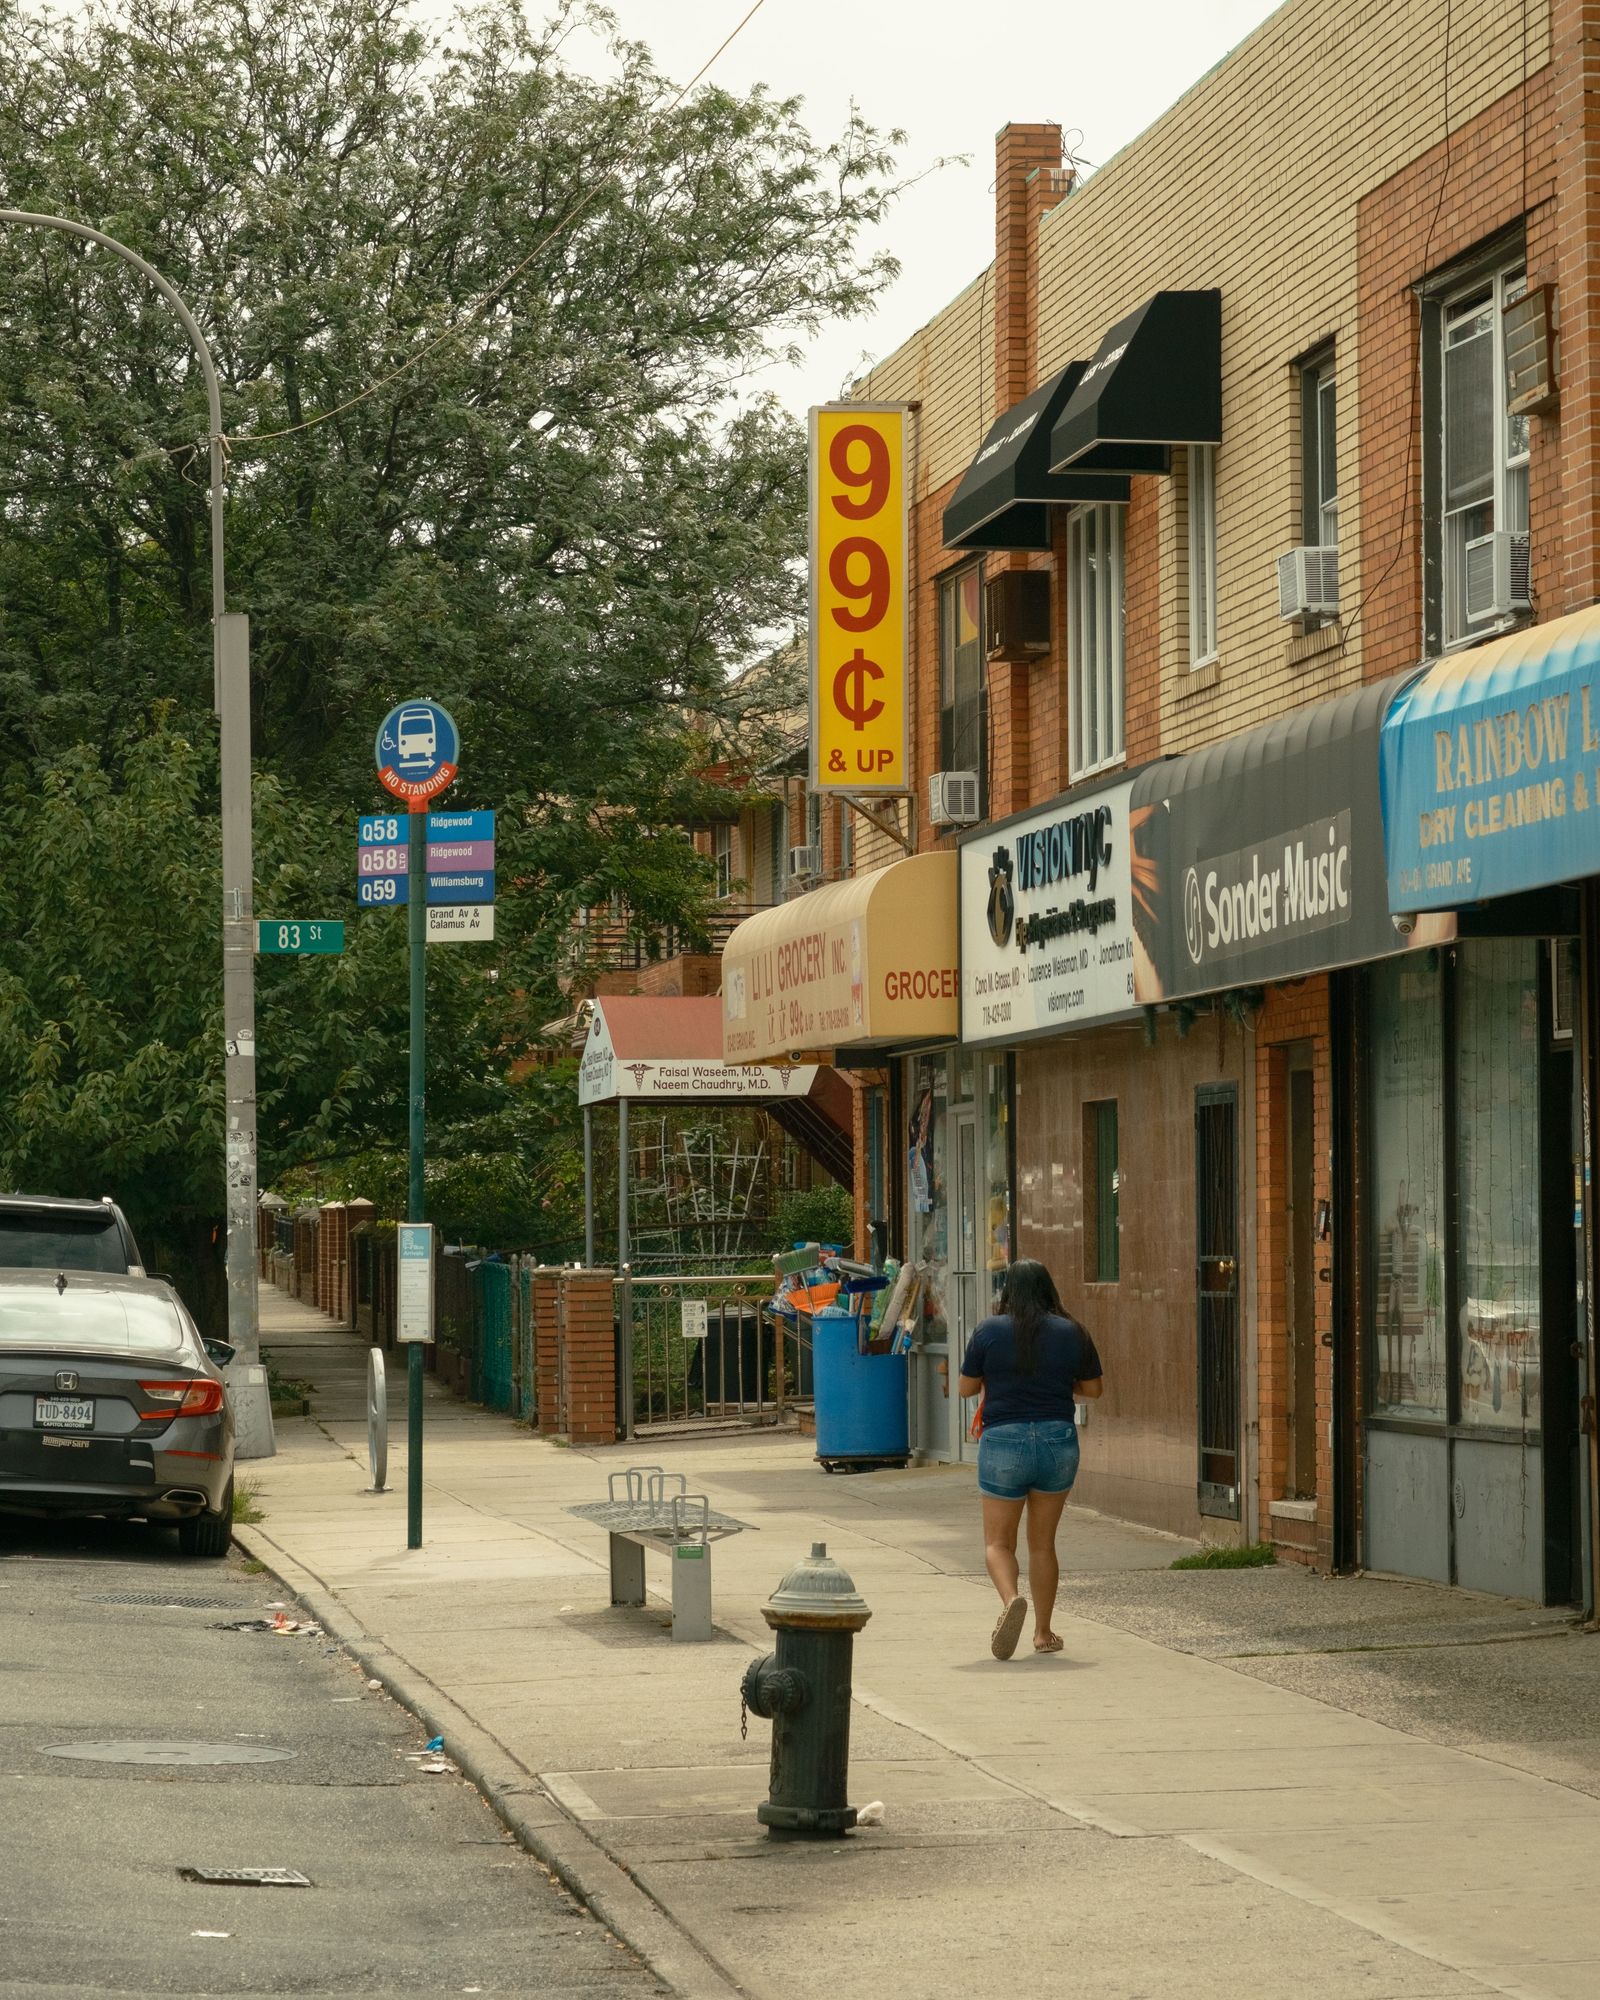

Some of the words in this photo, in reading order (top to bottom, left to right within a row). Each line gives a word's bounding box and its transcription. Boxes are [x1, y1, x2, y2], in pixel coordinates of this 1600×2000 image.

[1434, 691, 1570, 793] RAINBOW
[828, 749, 847, 773] &
[856, 749, 894, 773] UP
[383, 769, 399, 787] NO
[399, 766, 450, 796] STANDING
[430, 816, 473, 829] Ridgewood
[1419, 806, 1457, 849] DRY
[1464, 777, 1566, 840] CLEANING
[1573, 772, 1589, 812] &
[362, 819, 398, 843] Q58
[362, 848, 397, 872] Q58
[430, 846, 473, 859] Ridgewood
[361, 878, 396, 902] Q59
[430, 876, 484, 888] Williamsburg
[1205, 854, 1280, 949] Sonder
[1284, 825, 1348, 926] Music
[430, 908, 454, 919] Grand
[458, 908, 470, 918] Av
[473, 908, 480, 918] &
[430, 919, 465, 930] Calamus
[470, 919, 481, 929] Av
[278, 925, 301, 949] 83
[310, 925, 322, 940] St
[777, 931, 827, 993] GROCERY
[832, 938, 847, 975] INC.
[1027, 963, 1052, 984] Laurence
[1080, 948, 1089, 971] MD
[1100, 941, 1125, 965] Jonathan
[1047, 989, 1085, 1014] visionnyc.com
[659, 1066, 690, 1077] Faisal
[693, 1067, 740, 1078] Waseem,
[742, 1066, 765, 1077] M.D.
[653, 1079, 690, 1090] Naeem
[692, 1079, 746, 1091] Chaudhry,
[748, 1079, 771, 1089] M.D.
[38, 1404, 91, 1420] TUD-8494
